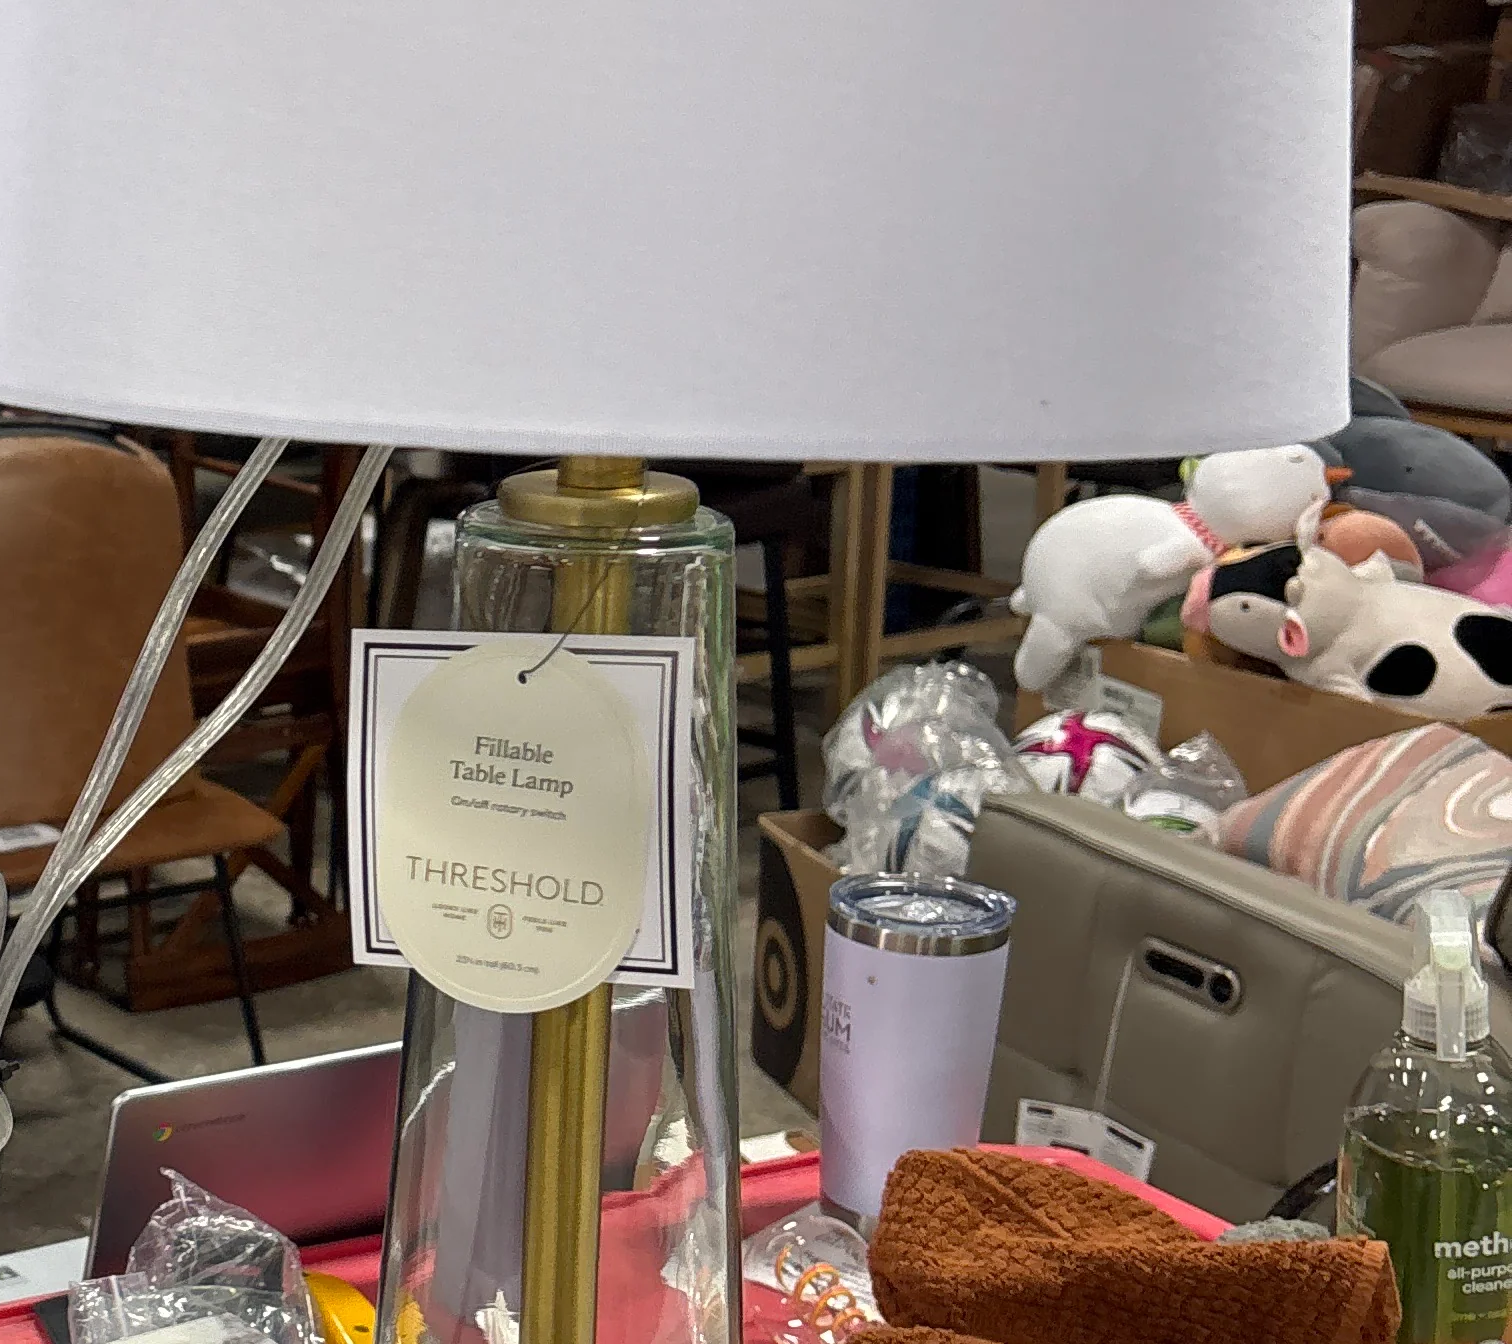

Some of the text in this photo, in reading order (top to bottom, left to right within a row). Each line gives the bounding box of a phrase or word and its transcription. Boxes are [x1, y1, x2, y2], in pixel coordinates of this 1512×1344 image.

[475, 736, 554, 765] Fillable
[449, 759, 574, 799] Table Lamp
[406, 855, 605, 906] THRESHOLD
[1434, 1231, 1512, 1259] meth
